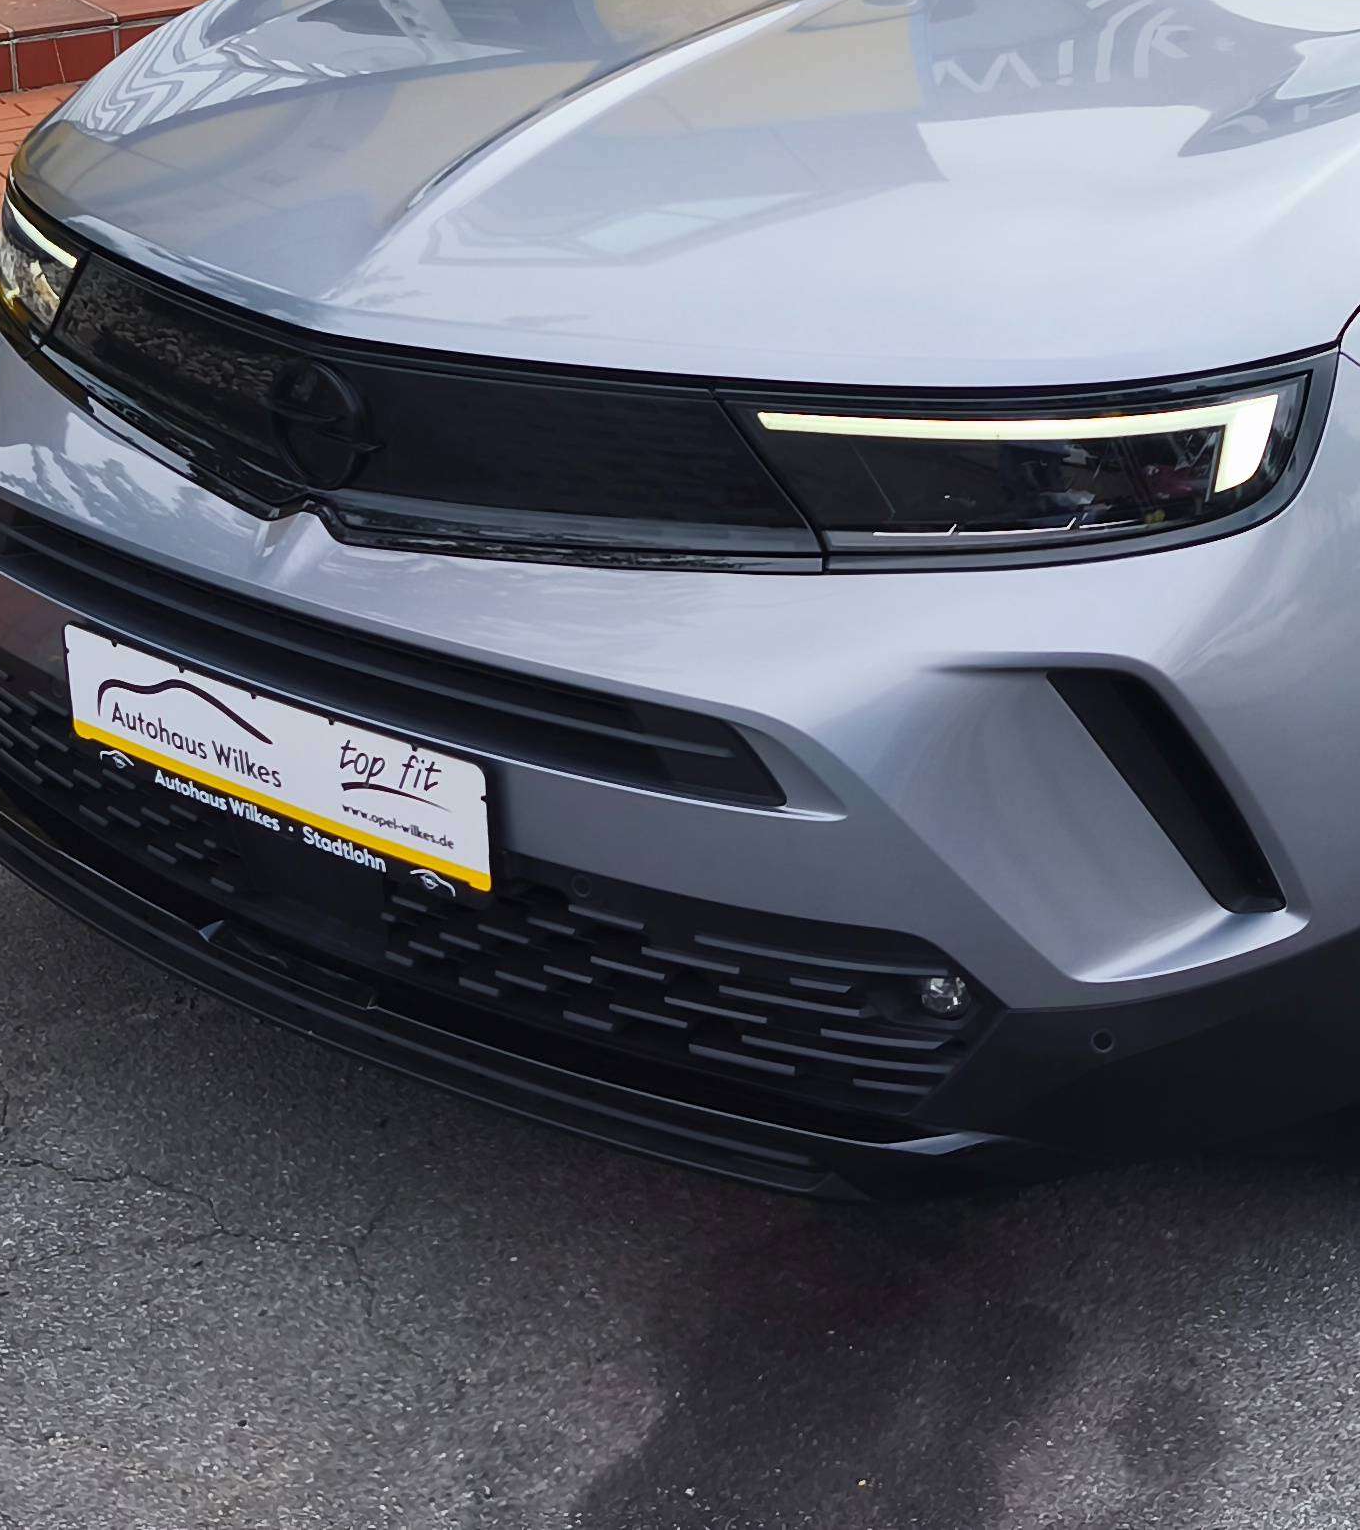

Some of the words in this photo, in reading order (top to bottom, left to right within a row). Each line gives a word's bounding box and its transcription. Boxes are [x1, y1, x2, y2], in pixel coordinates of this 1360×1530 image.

[111, 702, 208, 761] Autohaus
[212, 739, 283, 789] Wilkes
[339, 739, 387, 786] top
[398, 748, 443, 792] fit
[154, 769, 228, 812] Autohaus
[227, 796, 281, 833] Wilkes
[302, 825, 387, 873] Stadtlohn
[341, 803, 456, 851] www.opel-wilkes.de
